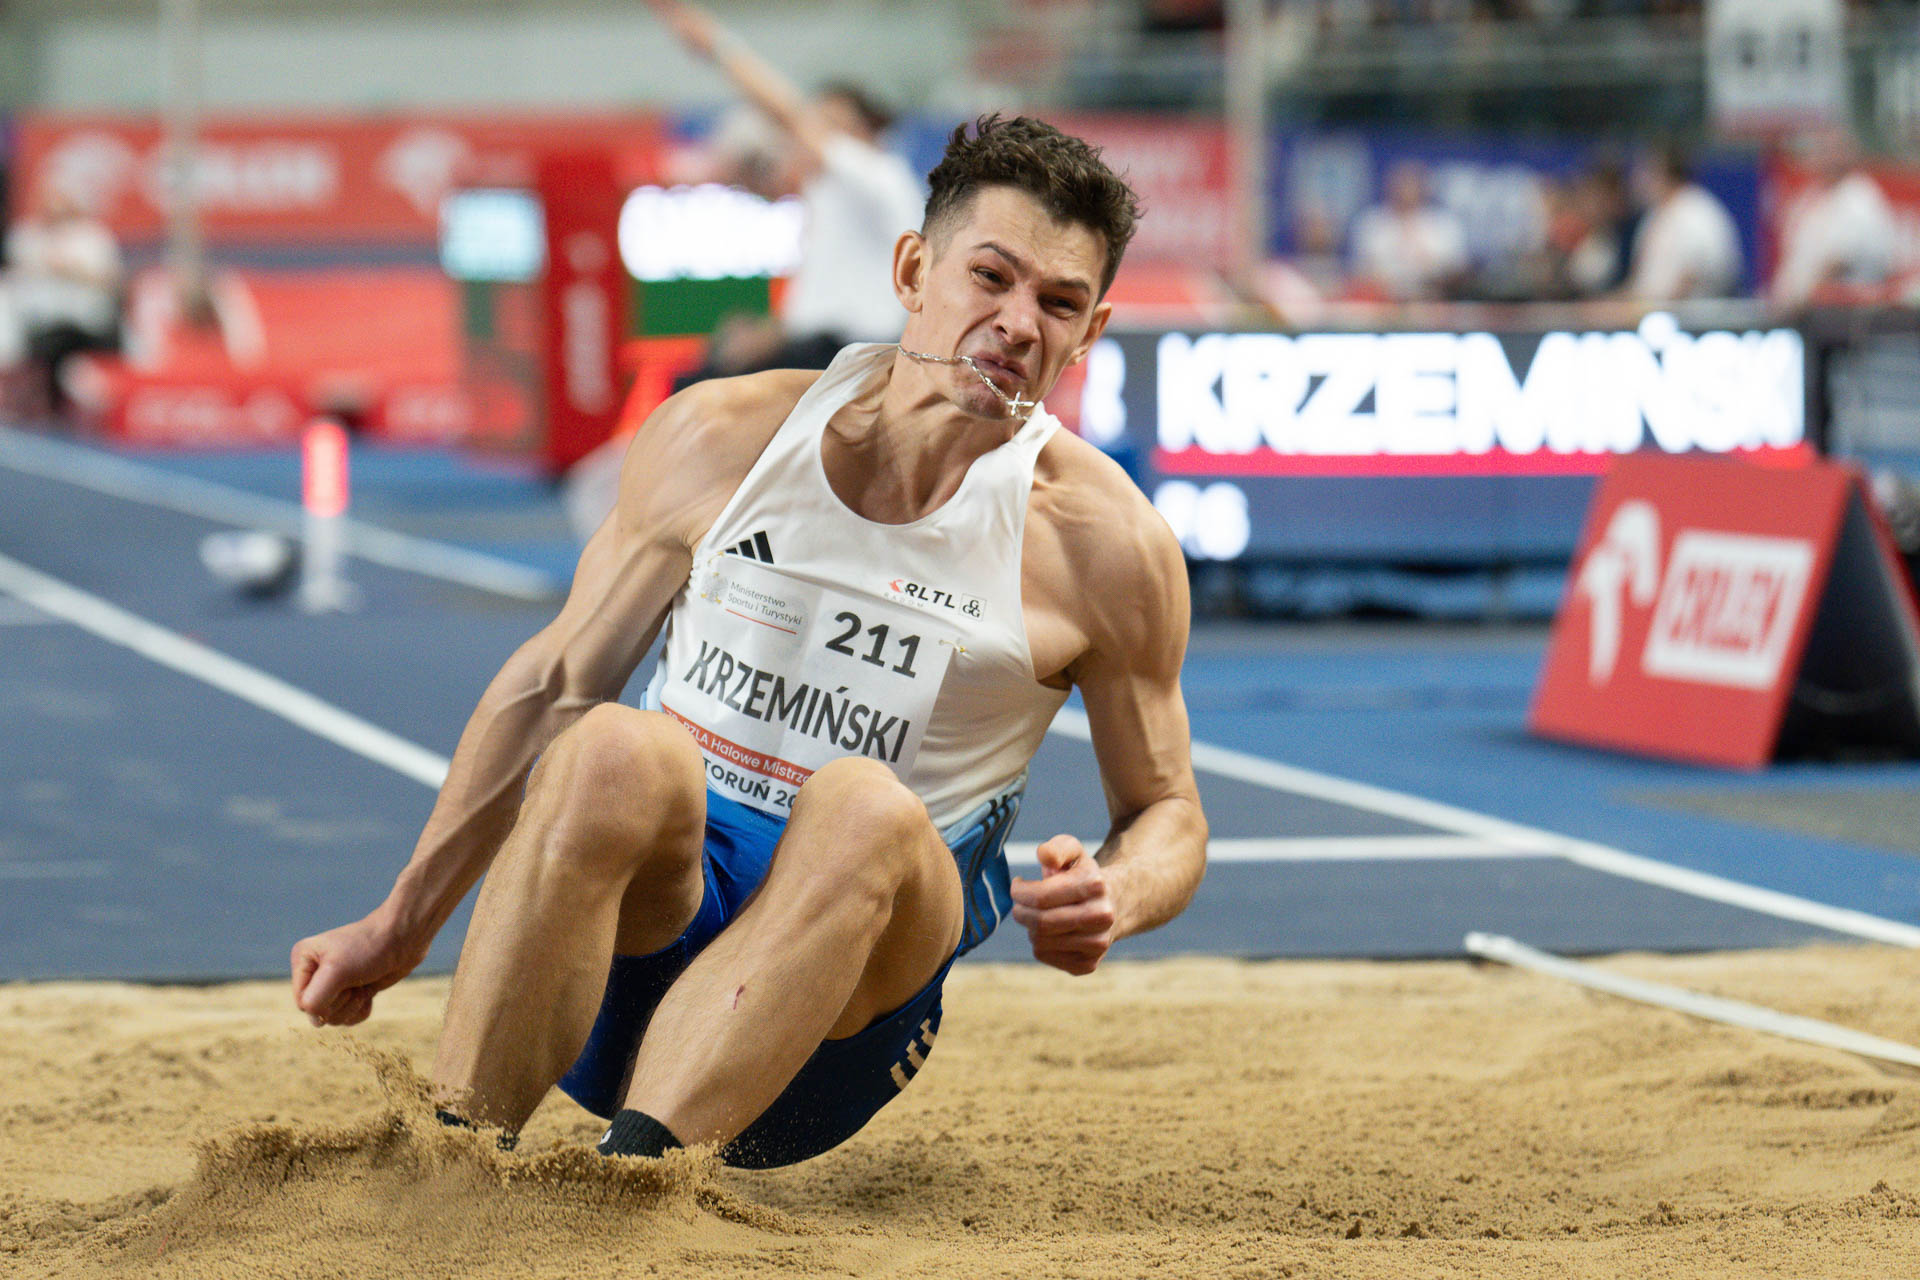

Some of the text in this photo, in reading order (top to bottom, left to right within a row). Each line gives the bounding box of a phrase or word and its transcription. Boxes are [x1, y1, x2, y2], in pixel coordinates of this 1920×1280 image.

[727, 592, 754, 611] Sportu
[760, 605, 803, 625] Turystyki
[730, 581, 786, 608] Ministerstwo
[905, 583, 956, 609] RLTL
[825, 611, 922, 679] 211
[683, 640, 911, 764] KRZEMIŃSKI
[711, 737, 760, 768] Halowe
[703, 757, 771, 801] TORUŃ
